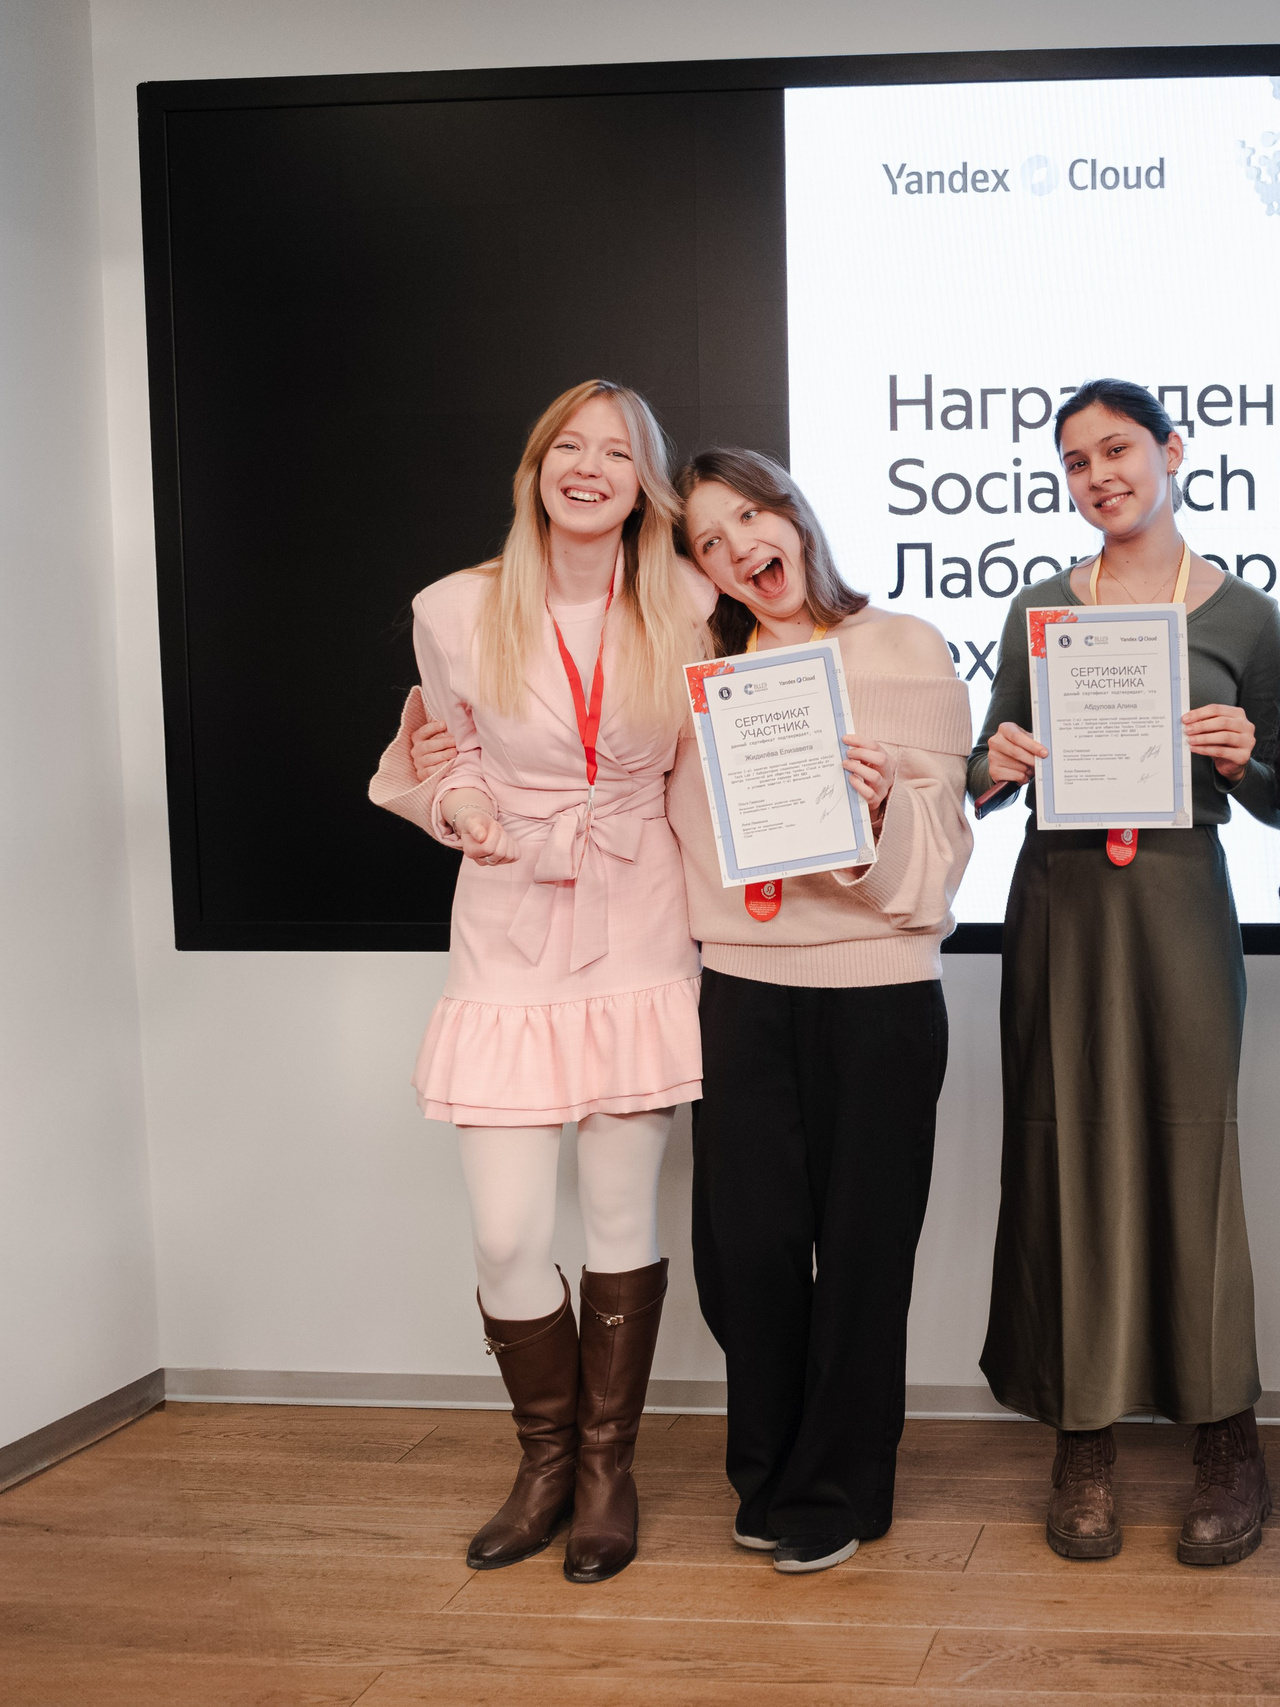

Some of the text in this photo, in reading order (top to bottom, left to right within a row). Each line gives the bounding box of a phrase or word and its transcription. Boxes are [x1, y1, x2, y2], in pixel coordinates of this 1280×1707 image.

[882, 157, 1165, 195] Yandex Cloud
[888, 457, 1078, 516] Socia
[1071, 666, 1148, 677] СЕРТИФИКАТ
[778, 679, 796, 687] Yandex
[1075, 678, 1145, 689] УЧАСТНИКА
[734, 706, 811, 729] СЕРТИФИКАТ
[740, 719, 809, 740] УЧАСТНИКА
